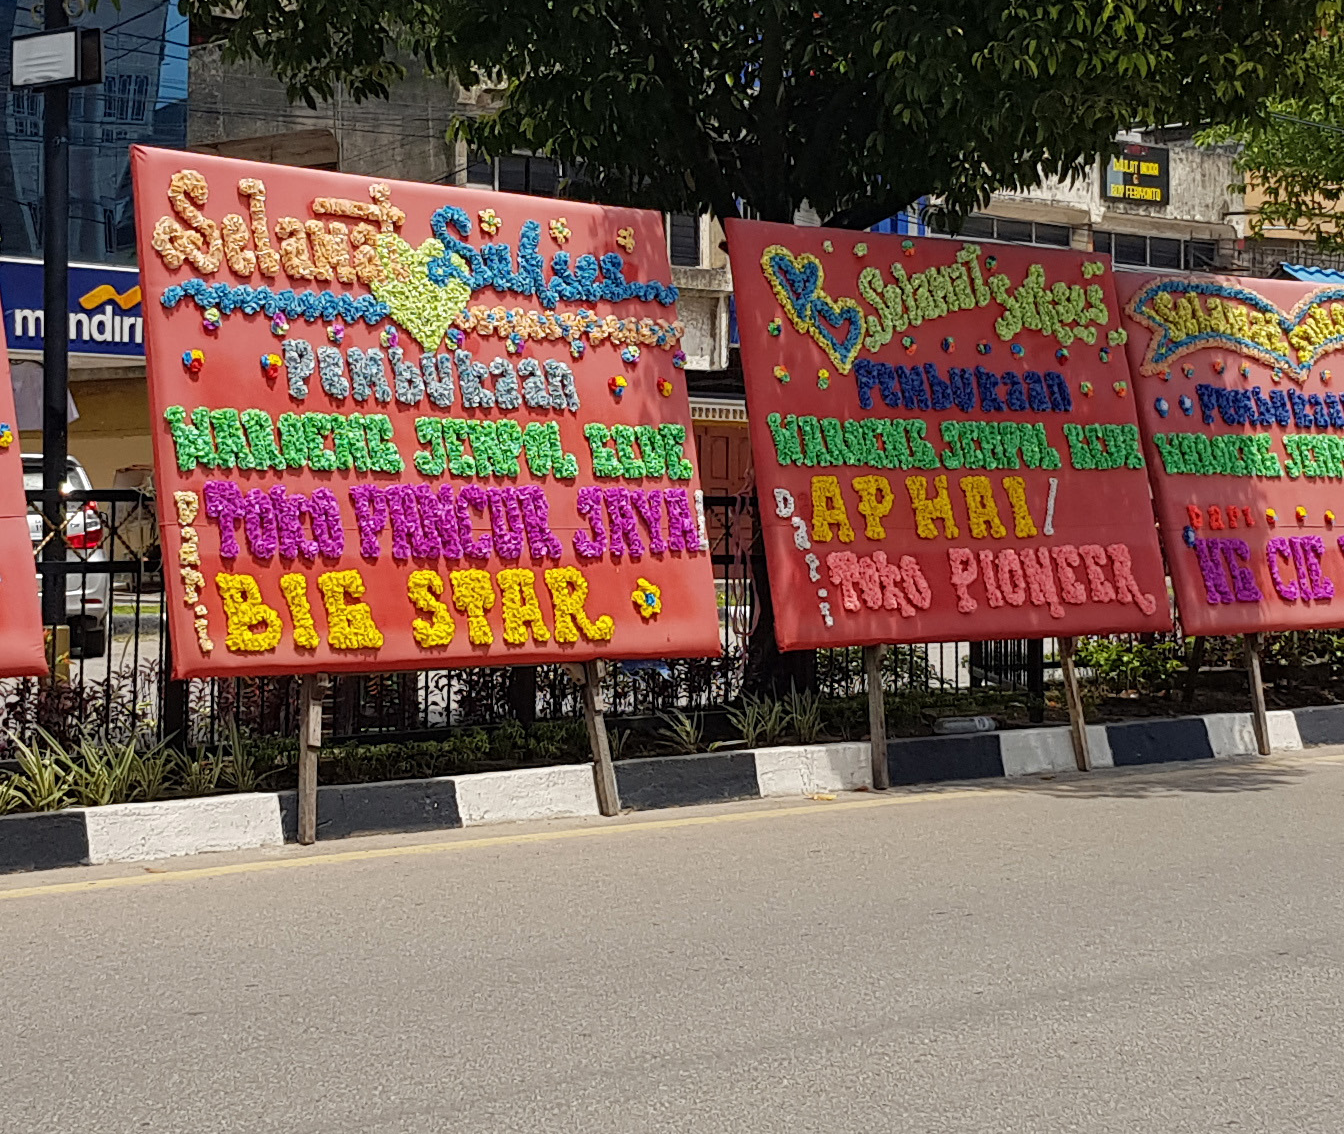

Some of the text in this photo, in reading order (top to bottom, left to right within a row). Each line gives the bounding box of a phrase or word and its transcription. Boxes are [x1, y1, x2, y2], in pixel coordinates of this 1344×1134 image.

[152, 169, 409, 285] Selamat
[14, 305, 143, 344] mndiri
[215, 566, 614, 651] BIG STAR
[948, 544, 1156, 619] PIONEER
